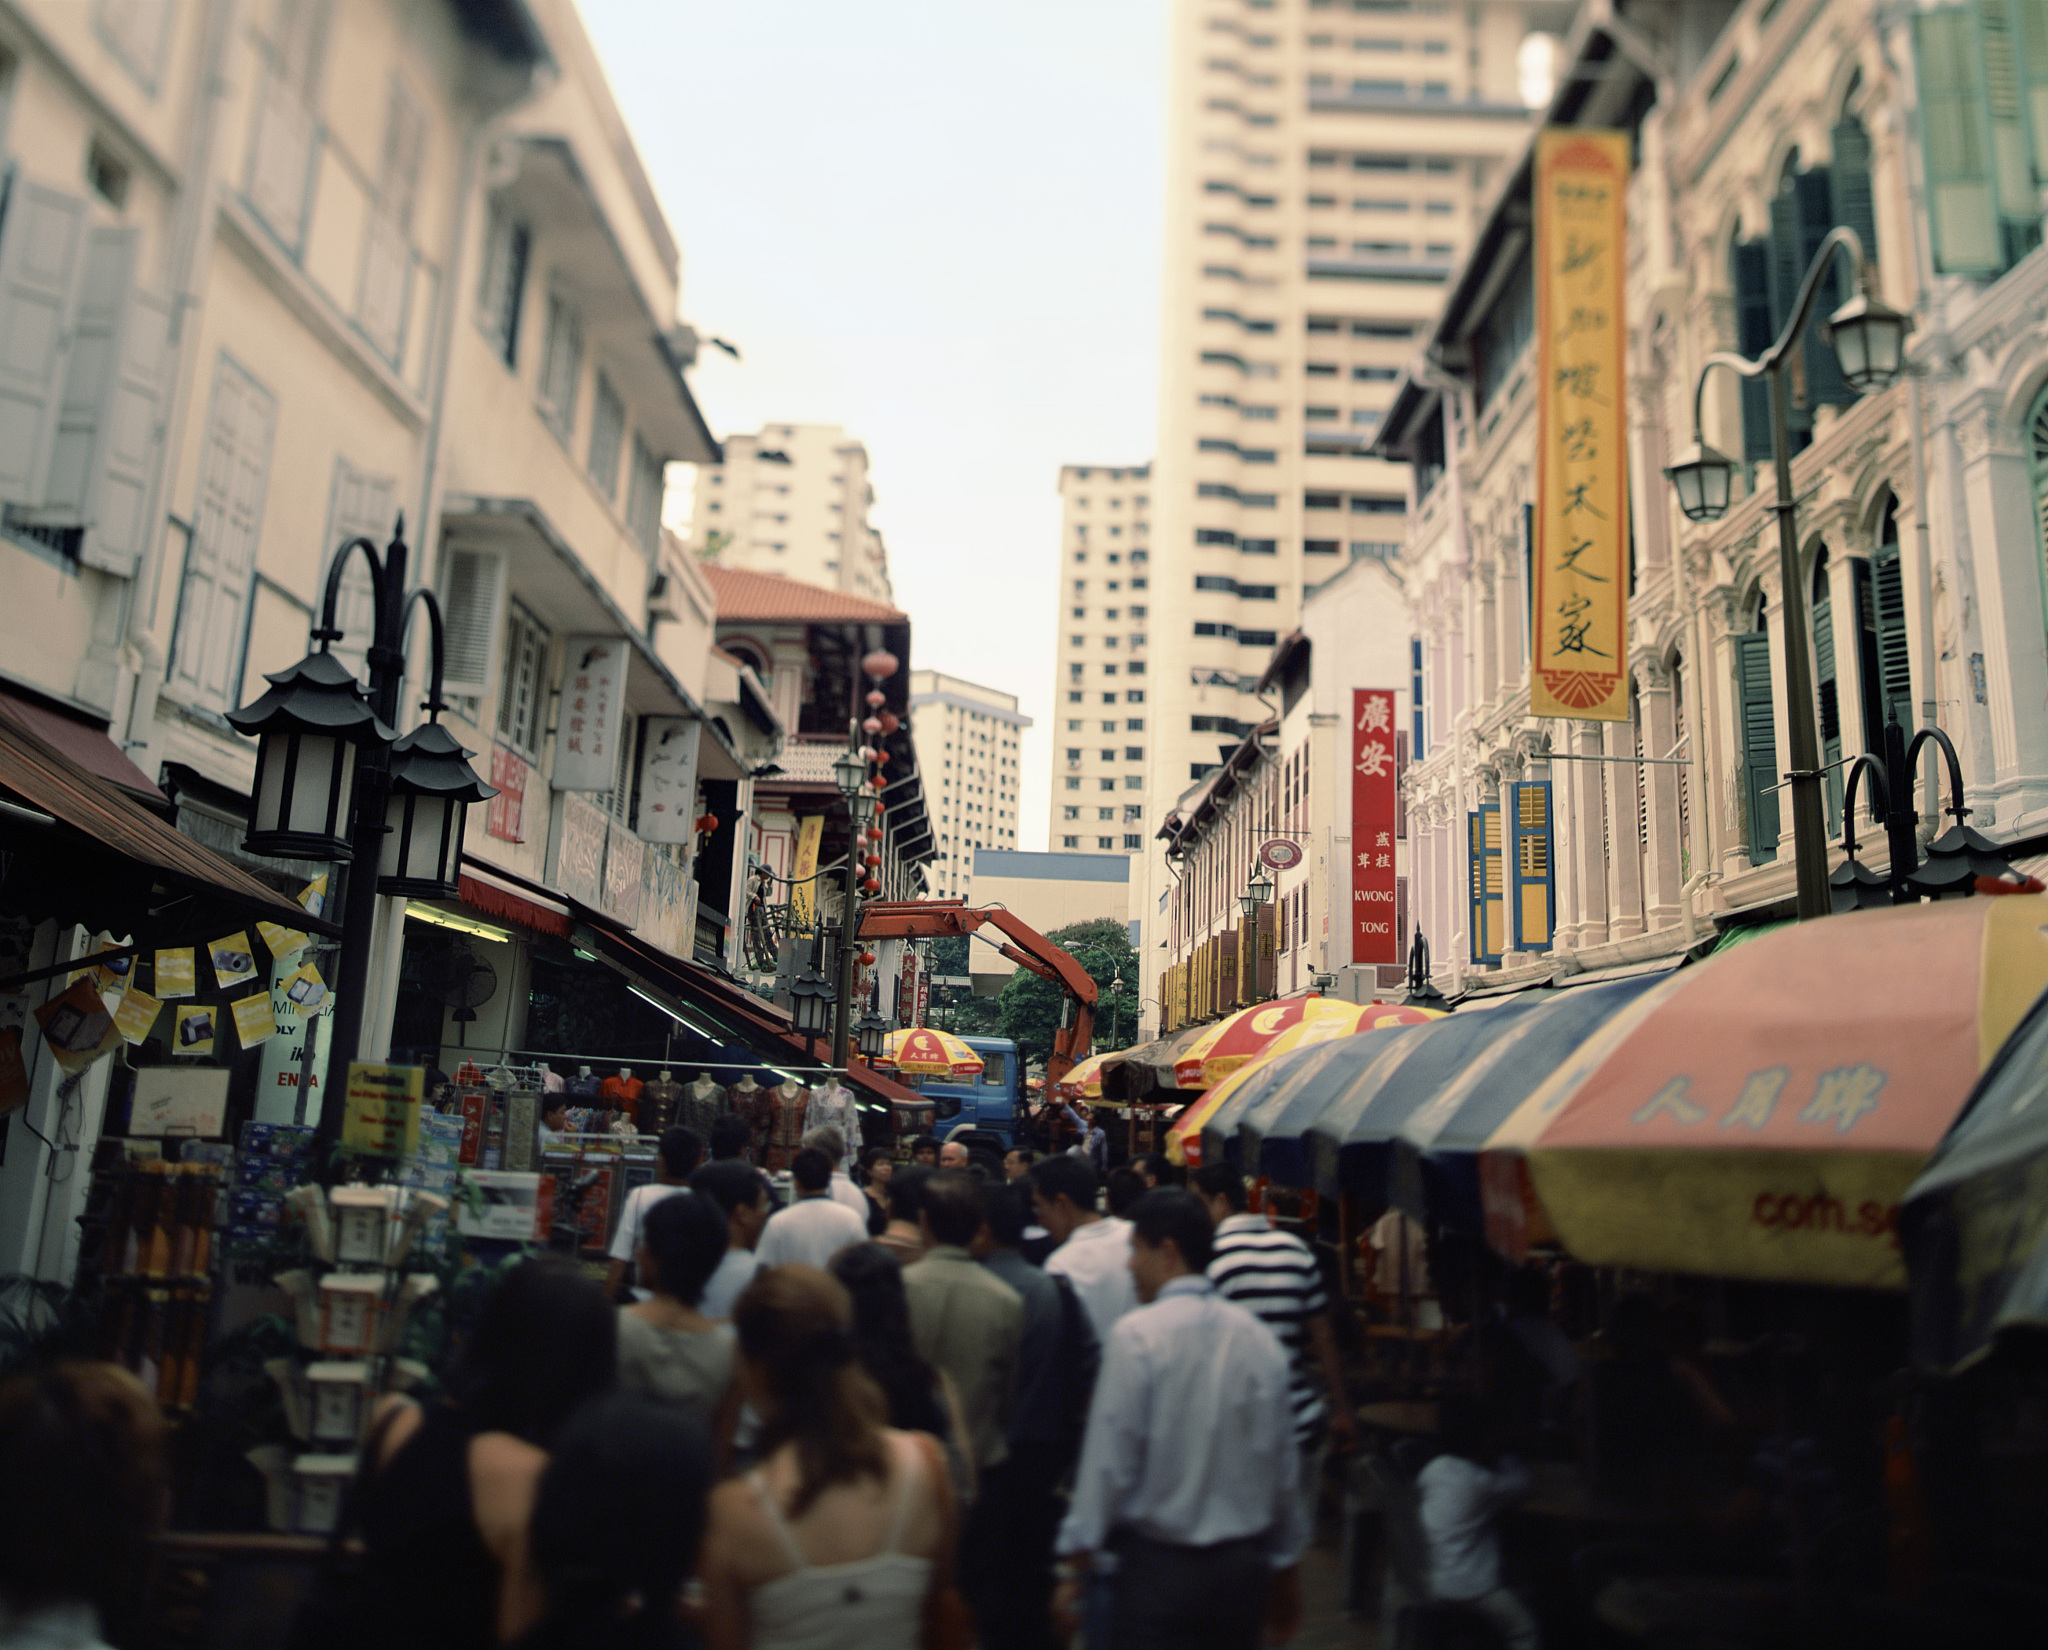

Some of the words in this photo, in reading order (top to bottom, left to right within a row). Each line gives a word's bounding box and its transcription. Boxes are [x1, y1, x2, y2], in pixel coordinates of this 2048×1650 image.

[1355, 693, 1394, 778] 廣安
[1354, 889, 1394, 902] KWONG
[1360, 921, 1389, 934] TONG
[253, 1125, 268, 1133] JVC
